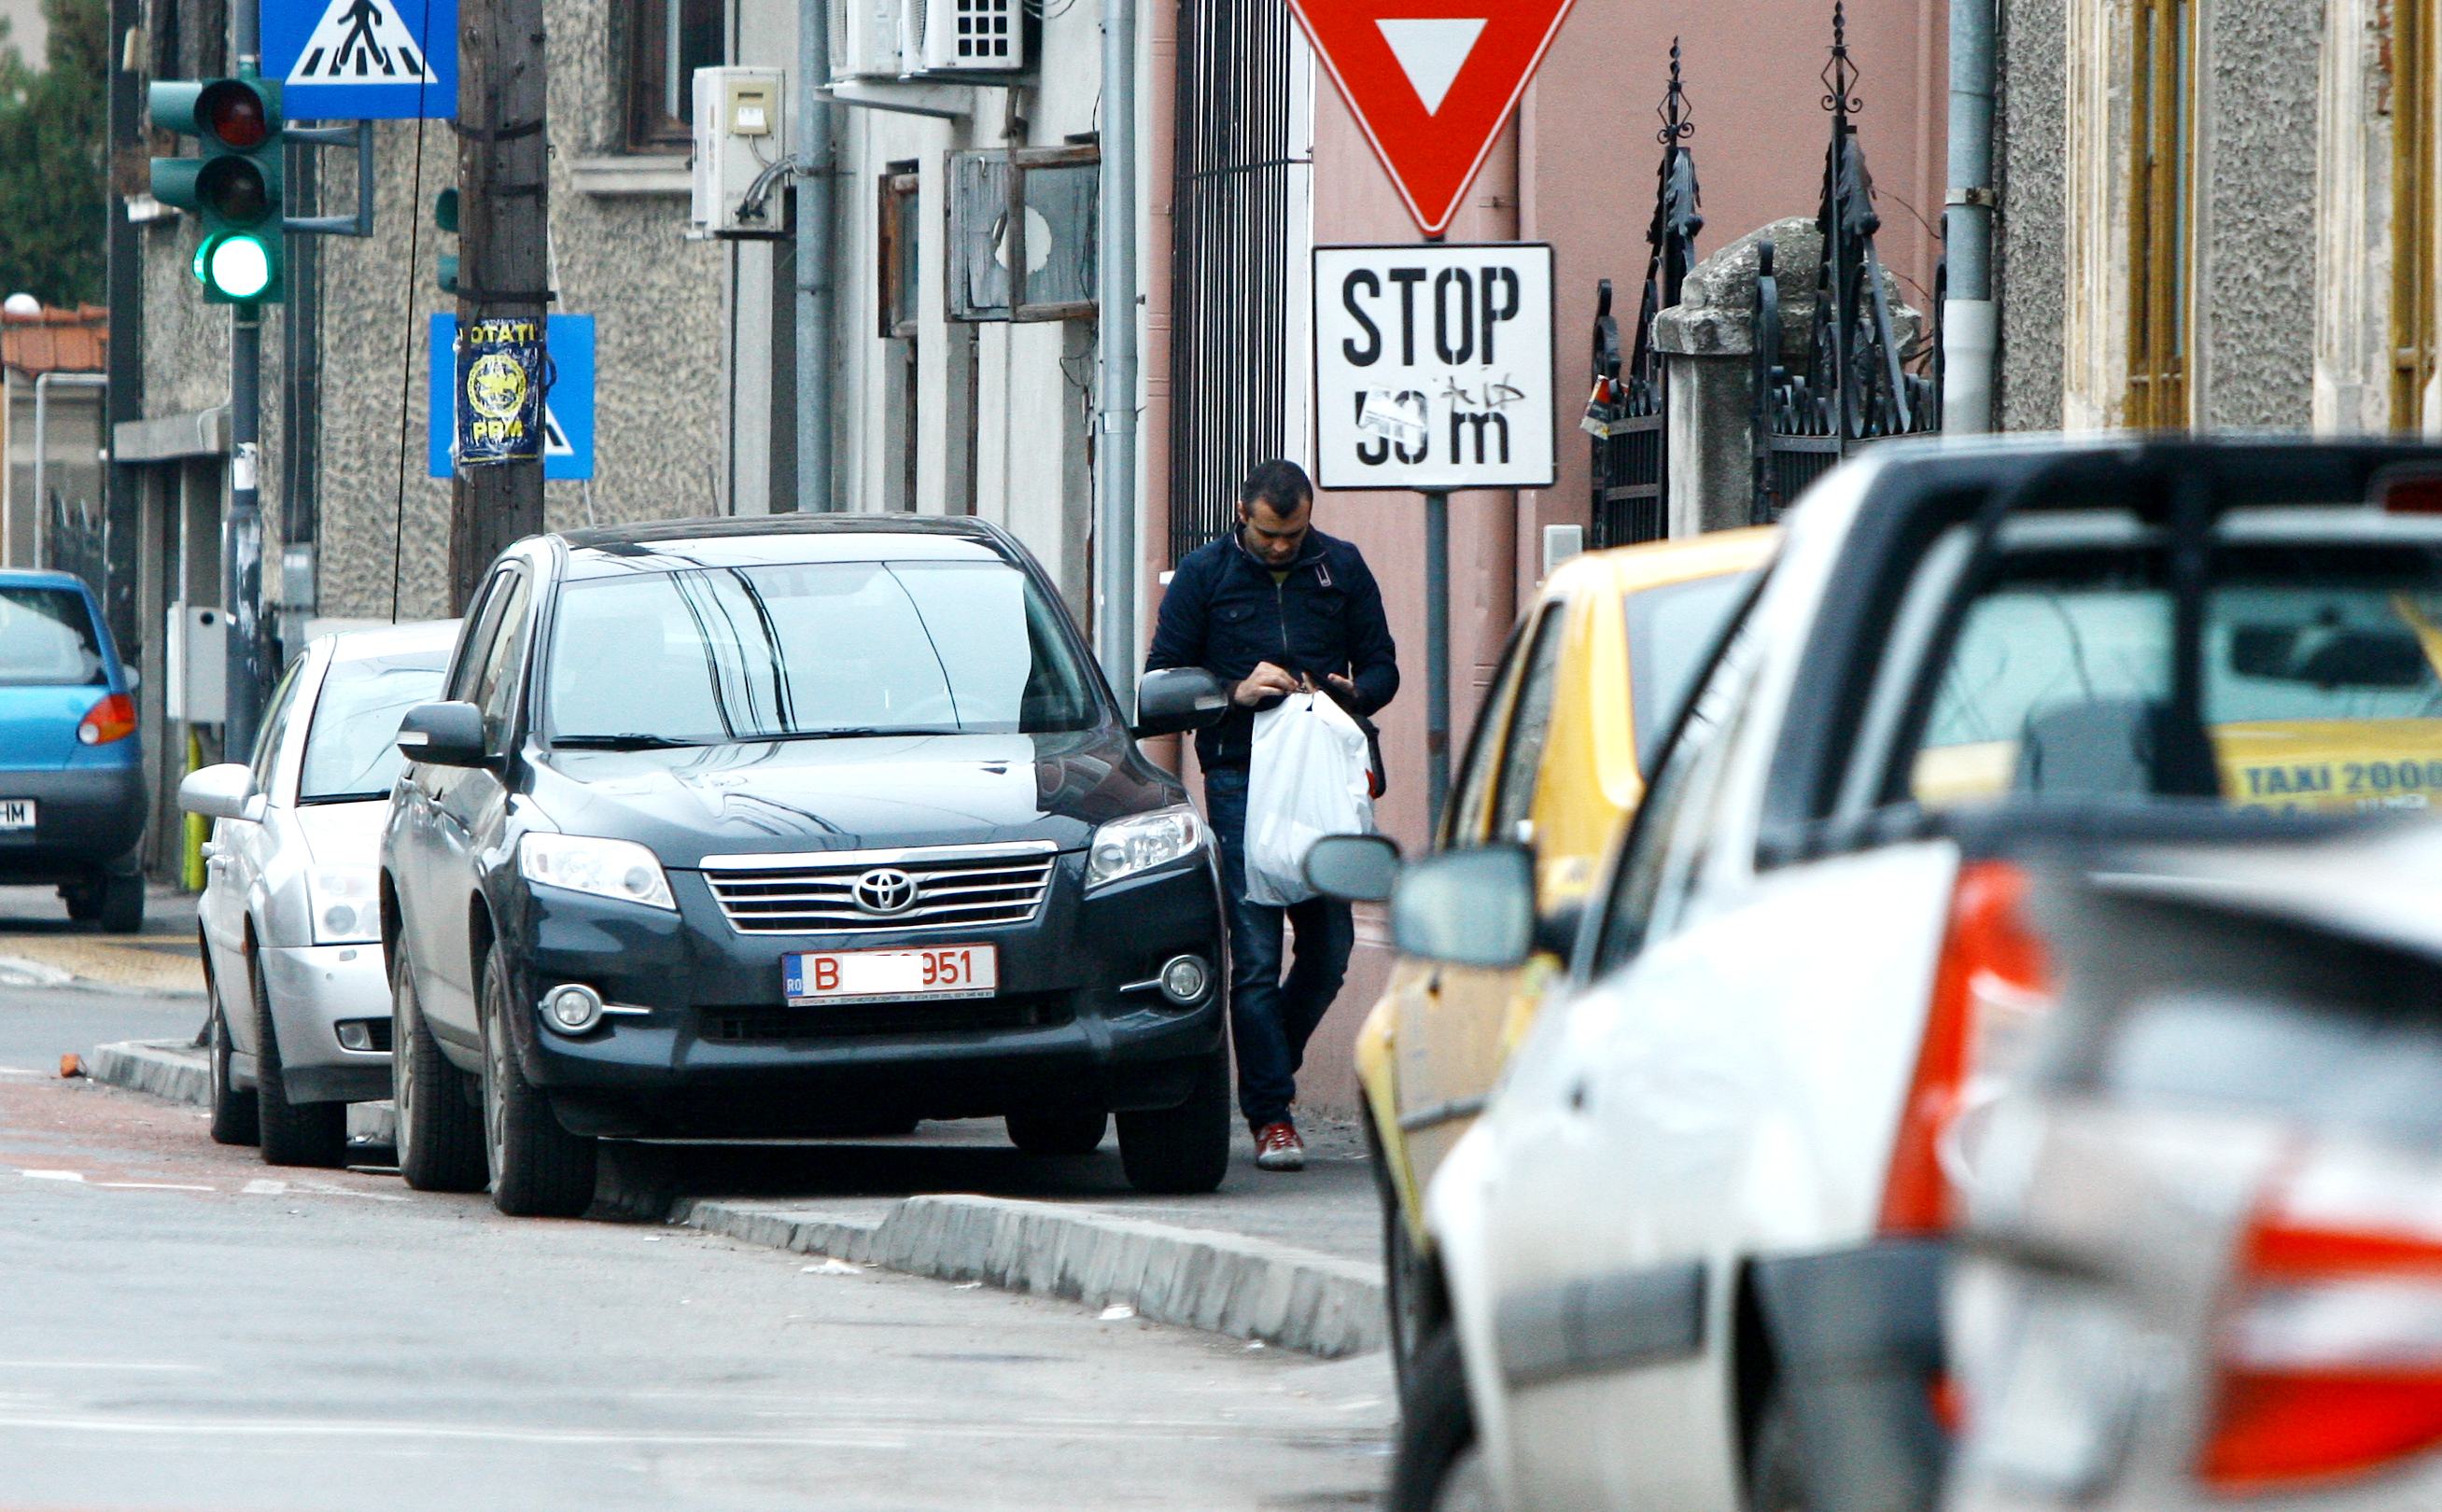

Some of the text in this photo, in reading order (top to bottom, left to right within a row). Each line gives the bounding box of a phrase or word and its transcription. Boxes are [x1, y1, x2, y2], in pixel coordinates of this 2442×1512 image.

[1342, 266, 1520, 367] STOP
[1451, 412, 1509, 464] m
[786, 978, 802, 992] RO
[815, 958, 839, 990] B
